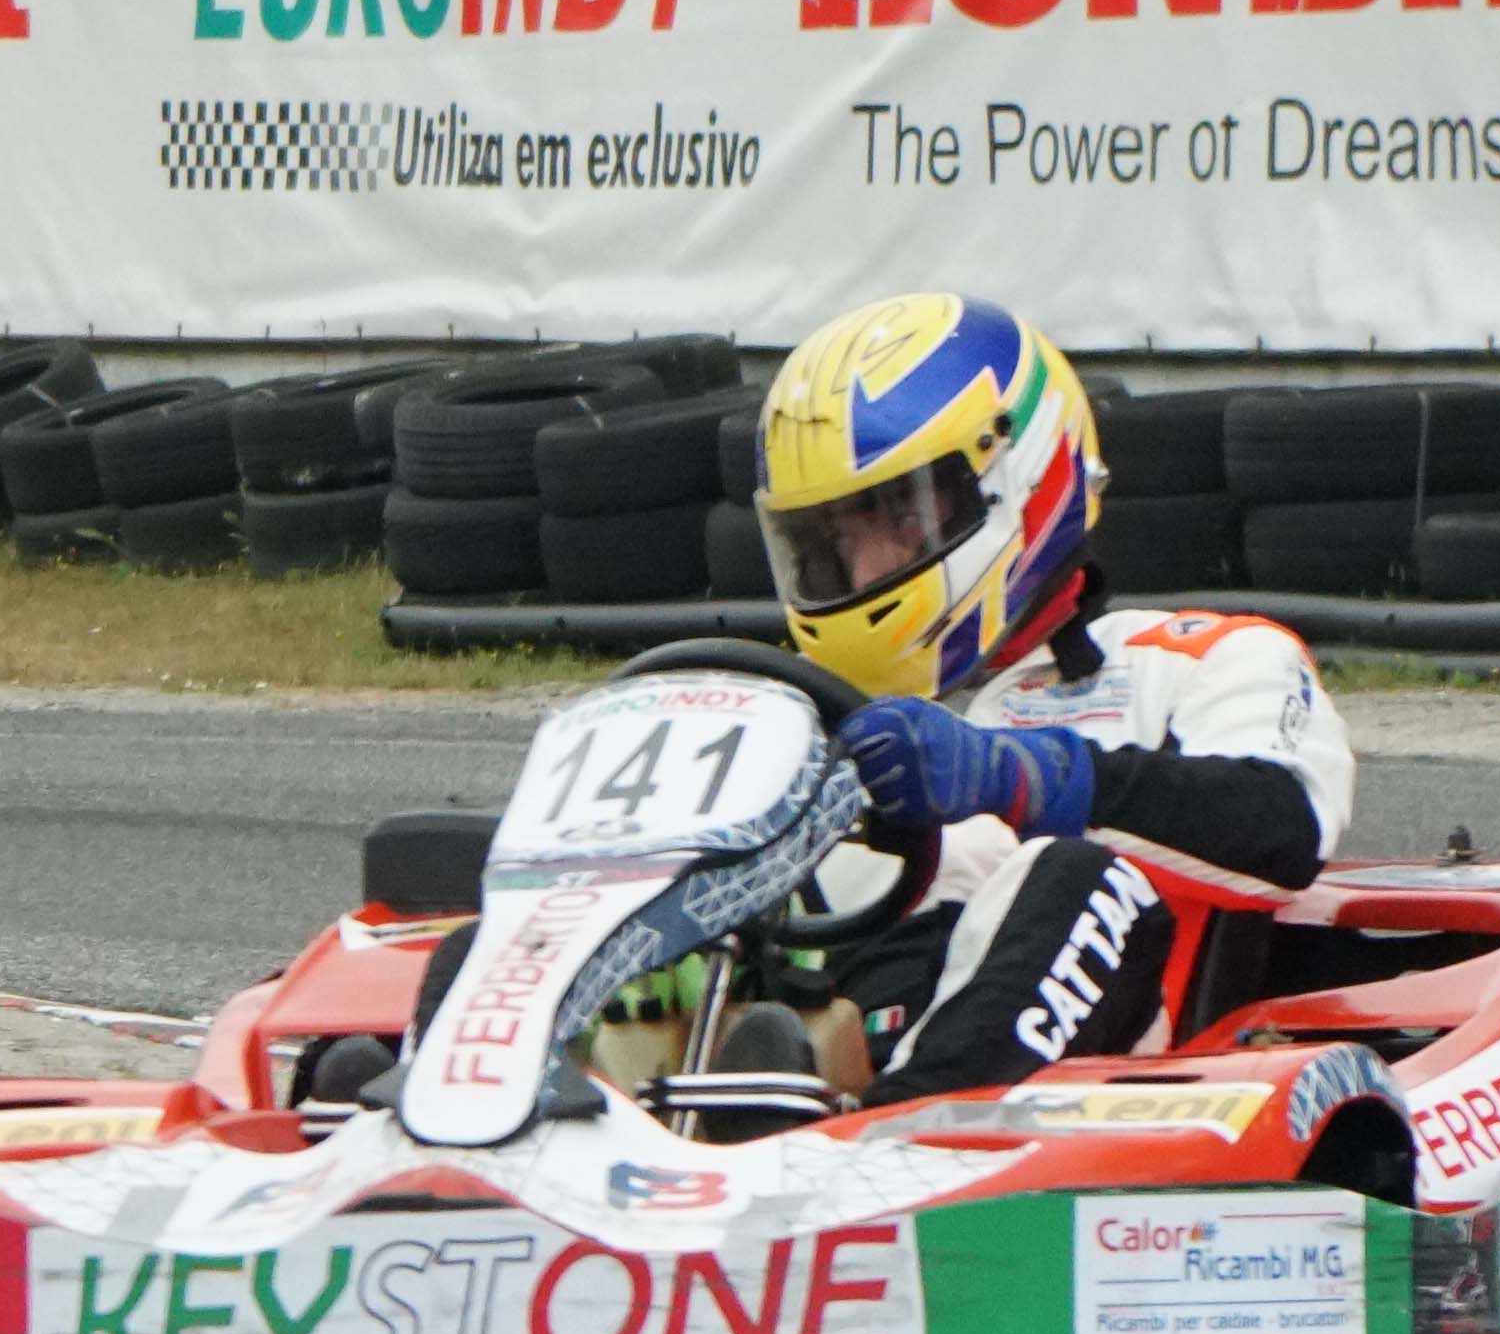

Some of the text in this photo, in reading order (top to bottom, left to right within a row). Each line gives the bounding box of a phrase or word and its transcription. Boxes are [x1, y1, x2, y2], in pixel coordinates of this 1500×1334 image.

[393, 101, 762, 189] Utiliza em exclusivo
[852, 103, 961, 187] The
[986, 102, 1170, 185] Power
[556, 689, 757, 733] UROINDY
[543, 718, 747, 824] 141
[443, 885, 602, 1087] FERBERTO
[1101, 1095, 1234, 1123] eni
[1097, 1218, 1186, 1252] Calor
[1184, 1246, 1292, 1281] Ricambi
